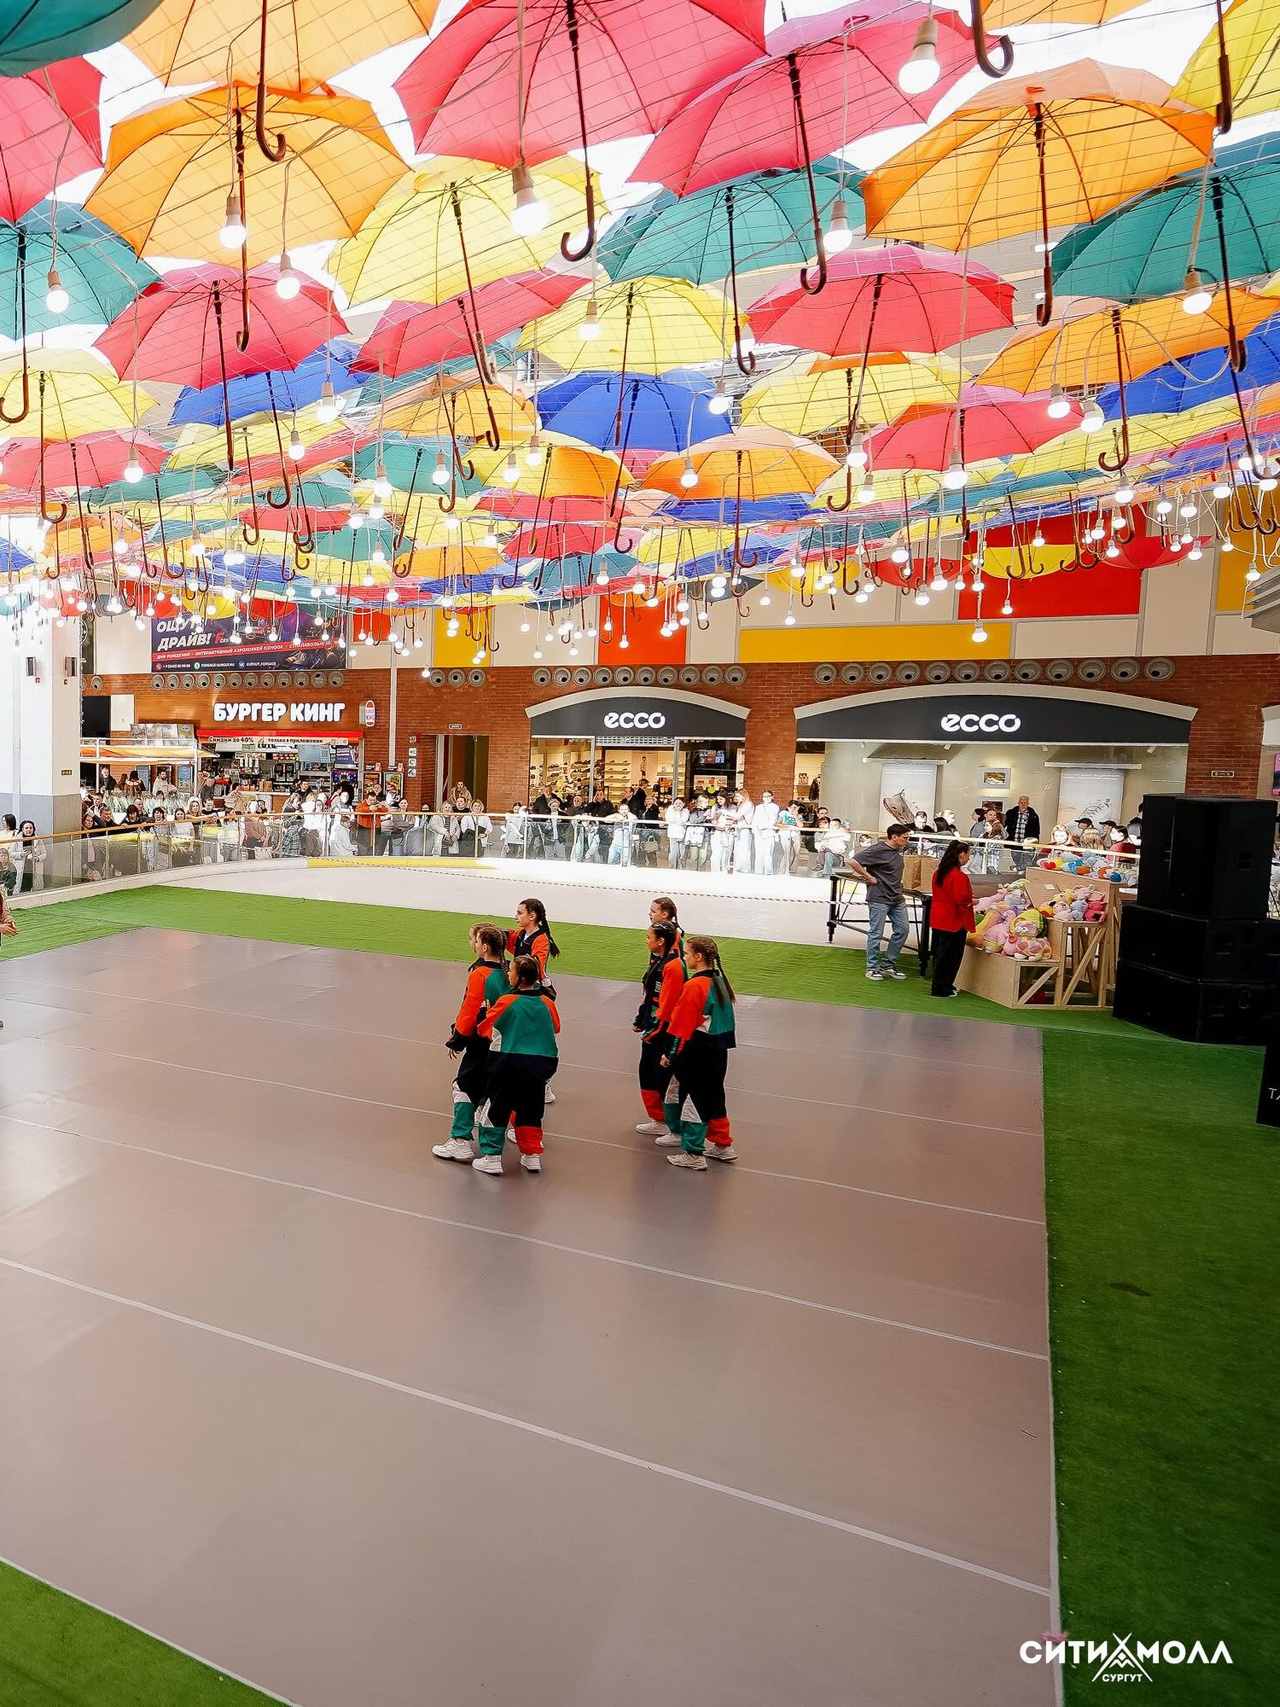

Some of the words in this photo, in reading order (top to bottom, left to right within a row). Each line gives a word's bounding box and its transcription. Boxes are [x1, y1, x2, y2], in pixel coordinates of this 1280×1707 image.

[157, 631, 212, 652] ДРАЙВ!
[213, 702, 287, 721] БУРГЕР
[290, 702, 345, 722] КИНГ
[603, 712, 666, 728] ecco
[941, 713, 1021, 732] ecco
